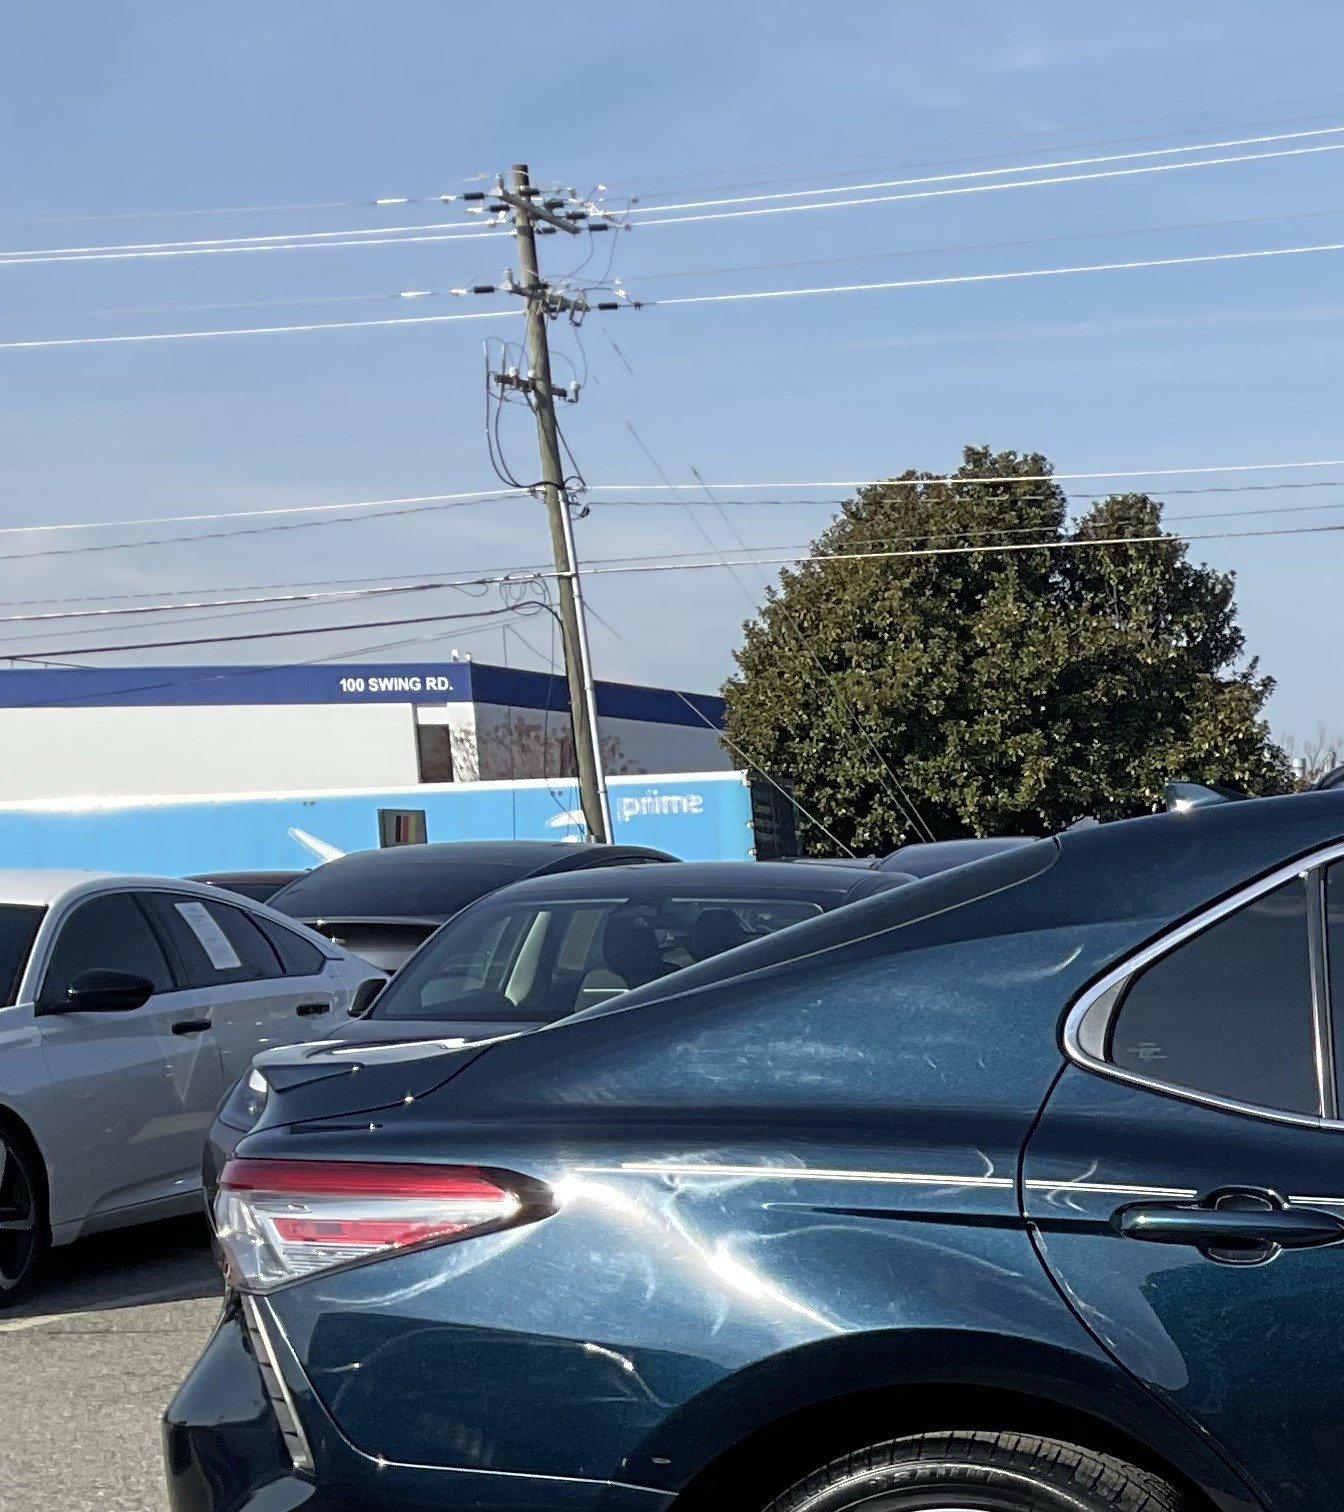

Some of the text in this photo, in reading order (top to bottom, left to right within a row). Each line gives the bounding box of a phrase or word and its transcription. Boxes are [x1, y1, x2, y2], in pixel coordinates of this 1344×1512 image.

[339, 676, 454, 692] 100 SWING RD.
[618, 789, 704, 823] prime
